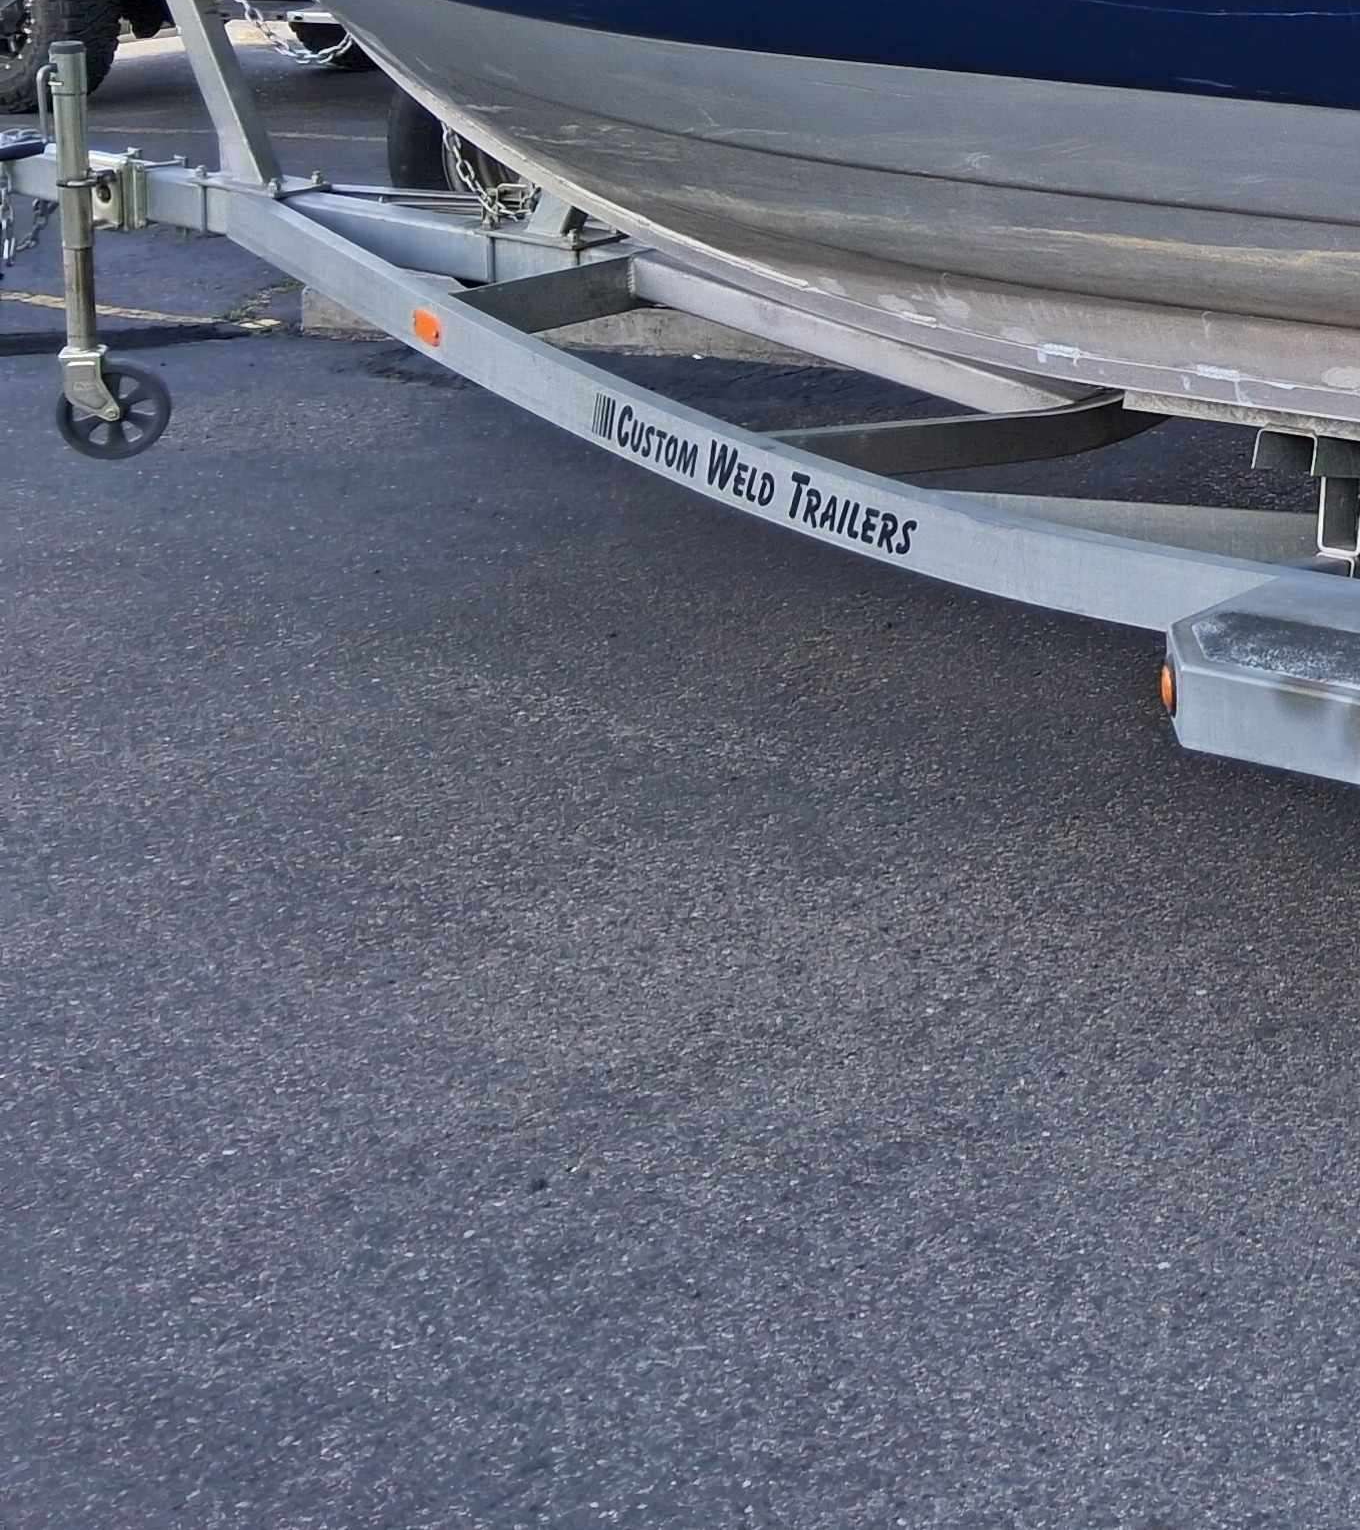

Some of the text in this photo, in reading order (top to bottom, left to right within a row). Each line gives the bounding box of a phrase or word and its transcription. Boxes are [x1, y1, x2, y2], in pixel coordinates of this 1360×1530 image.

[616, 405, 918, 556] CUSTOM WELD TRAILERS
